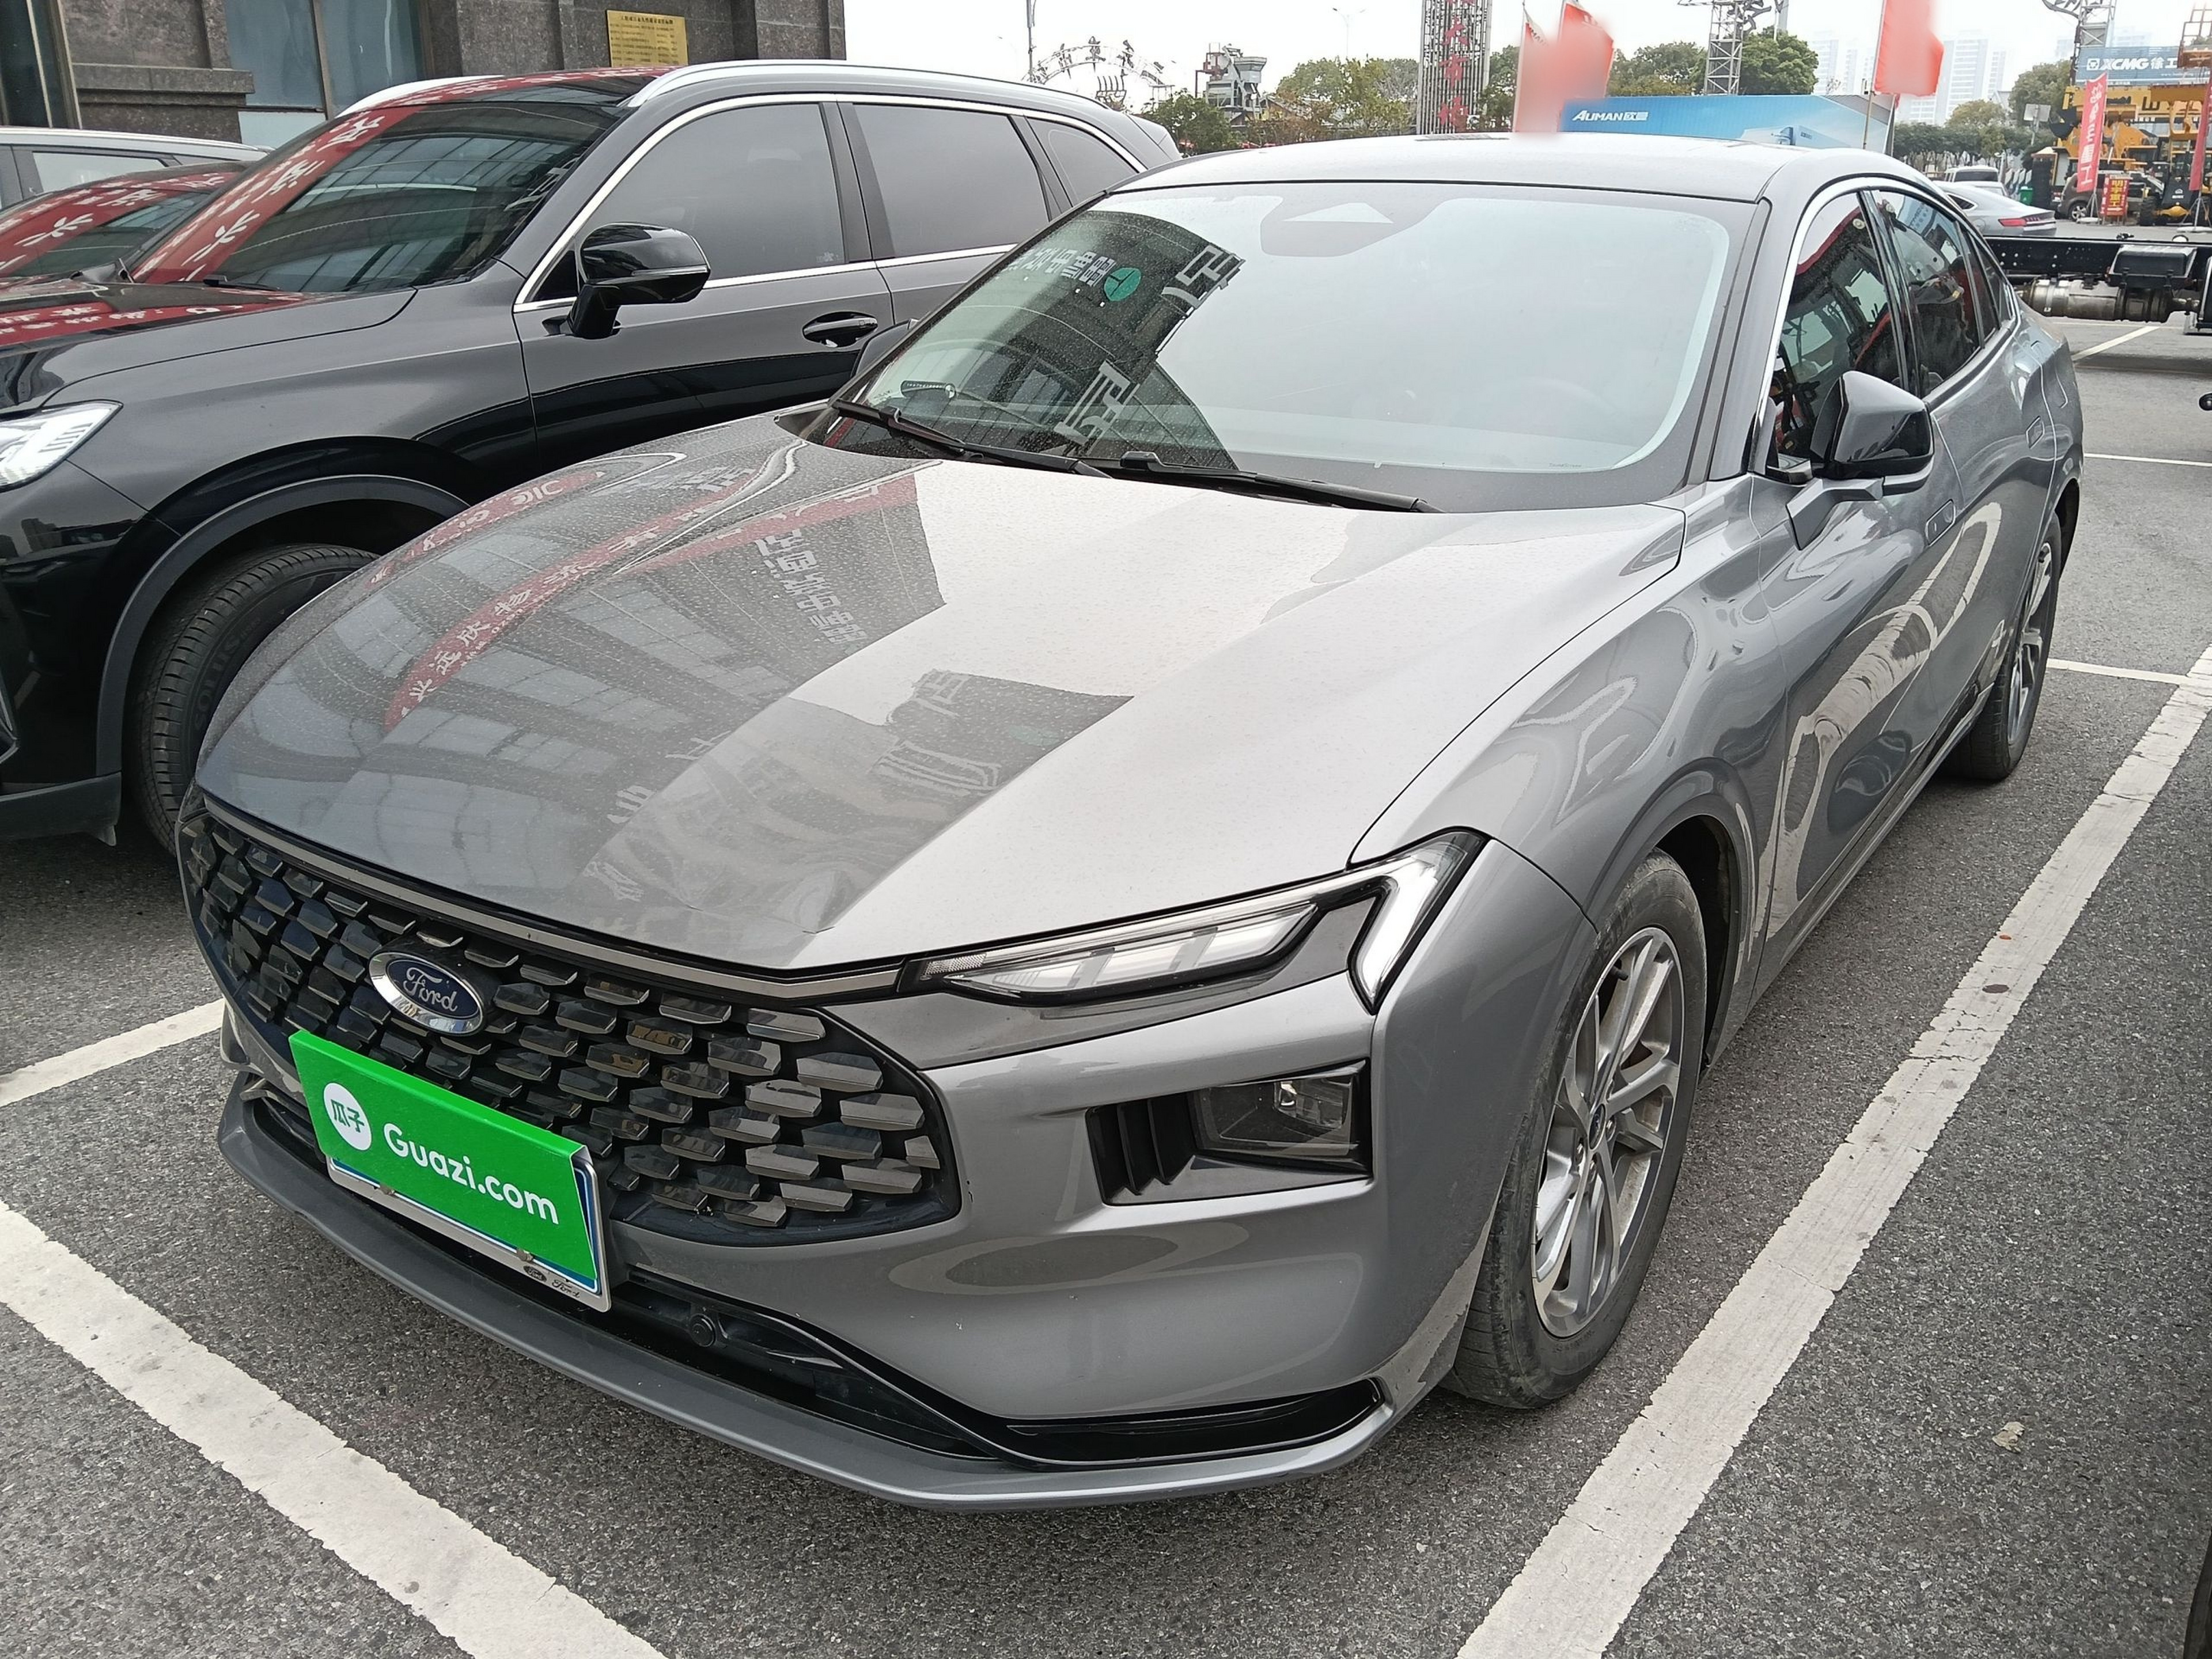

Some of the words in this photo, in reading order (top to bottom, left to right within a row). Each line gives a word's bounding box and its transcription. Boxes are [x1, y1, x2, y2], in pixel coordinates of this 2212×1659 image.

[1438, 0, 1475, 130] 大市场
[2100, 58, 2149, 70] XCMG
[1572, 110, 1623, 121] AUMAN
[403, 967, 458, 1012] Ford
[331, 1098, 366, 1134] 瓜子
[383, 1123, 559, 1225] Guazi.com
[551, 1279, 580, 1298] Ford
